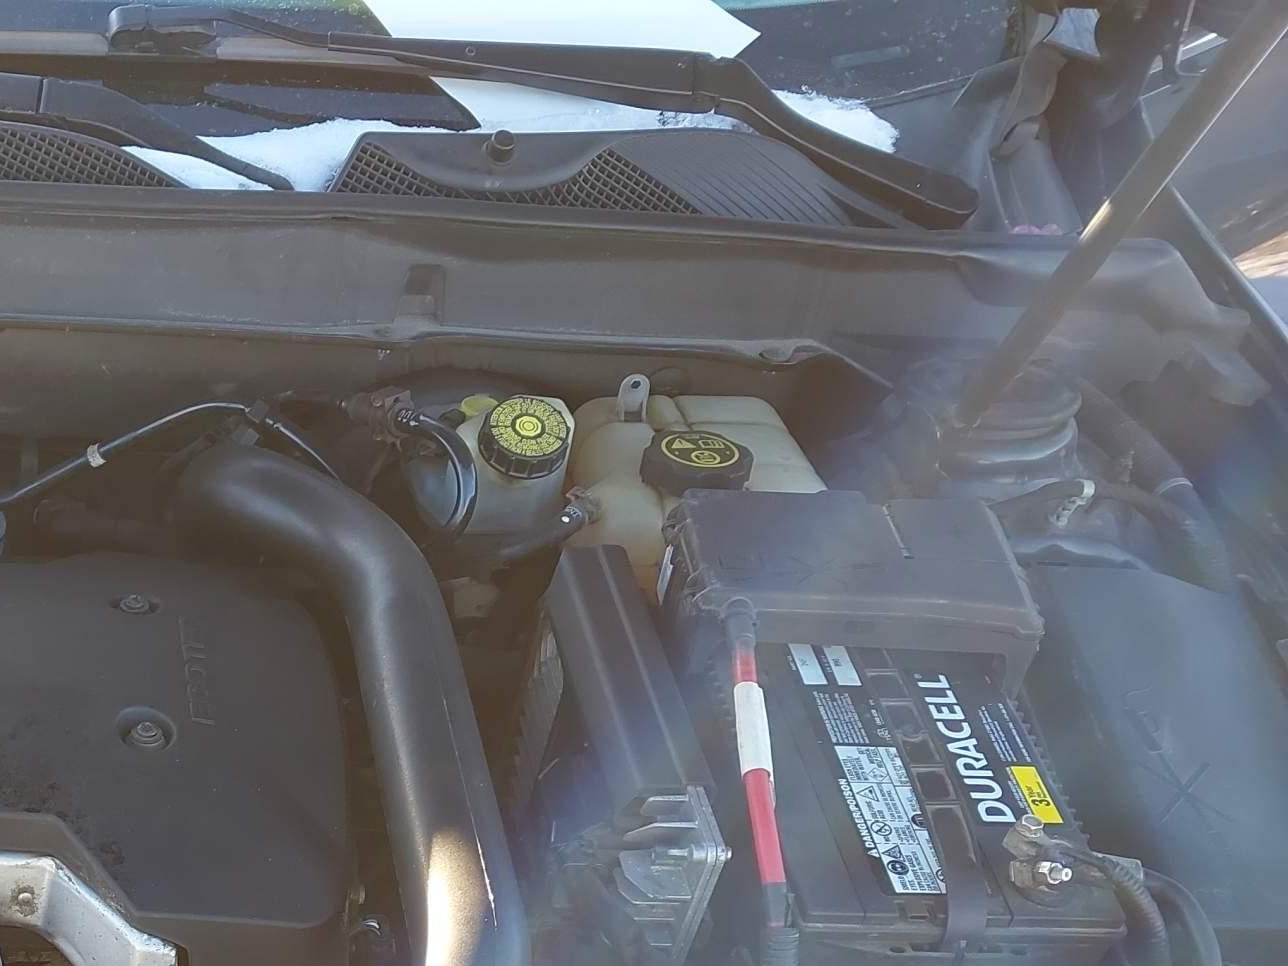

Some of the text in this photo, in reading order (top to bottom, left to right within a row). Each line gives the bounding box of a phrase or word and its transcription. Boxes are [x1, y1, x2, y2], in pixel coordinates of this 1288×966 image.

[917, 675, 1017, 823] DURACELL
[838, 778, 876, 849] DANGER/POISON
[1030, 798, 1051, 807] 3
